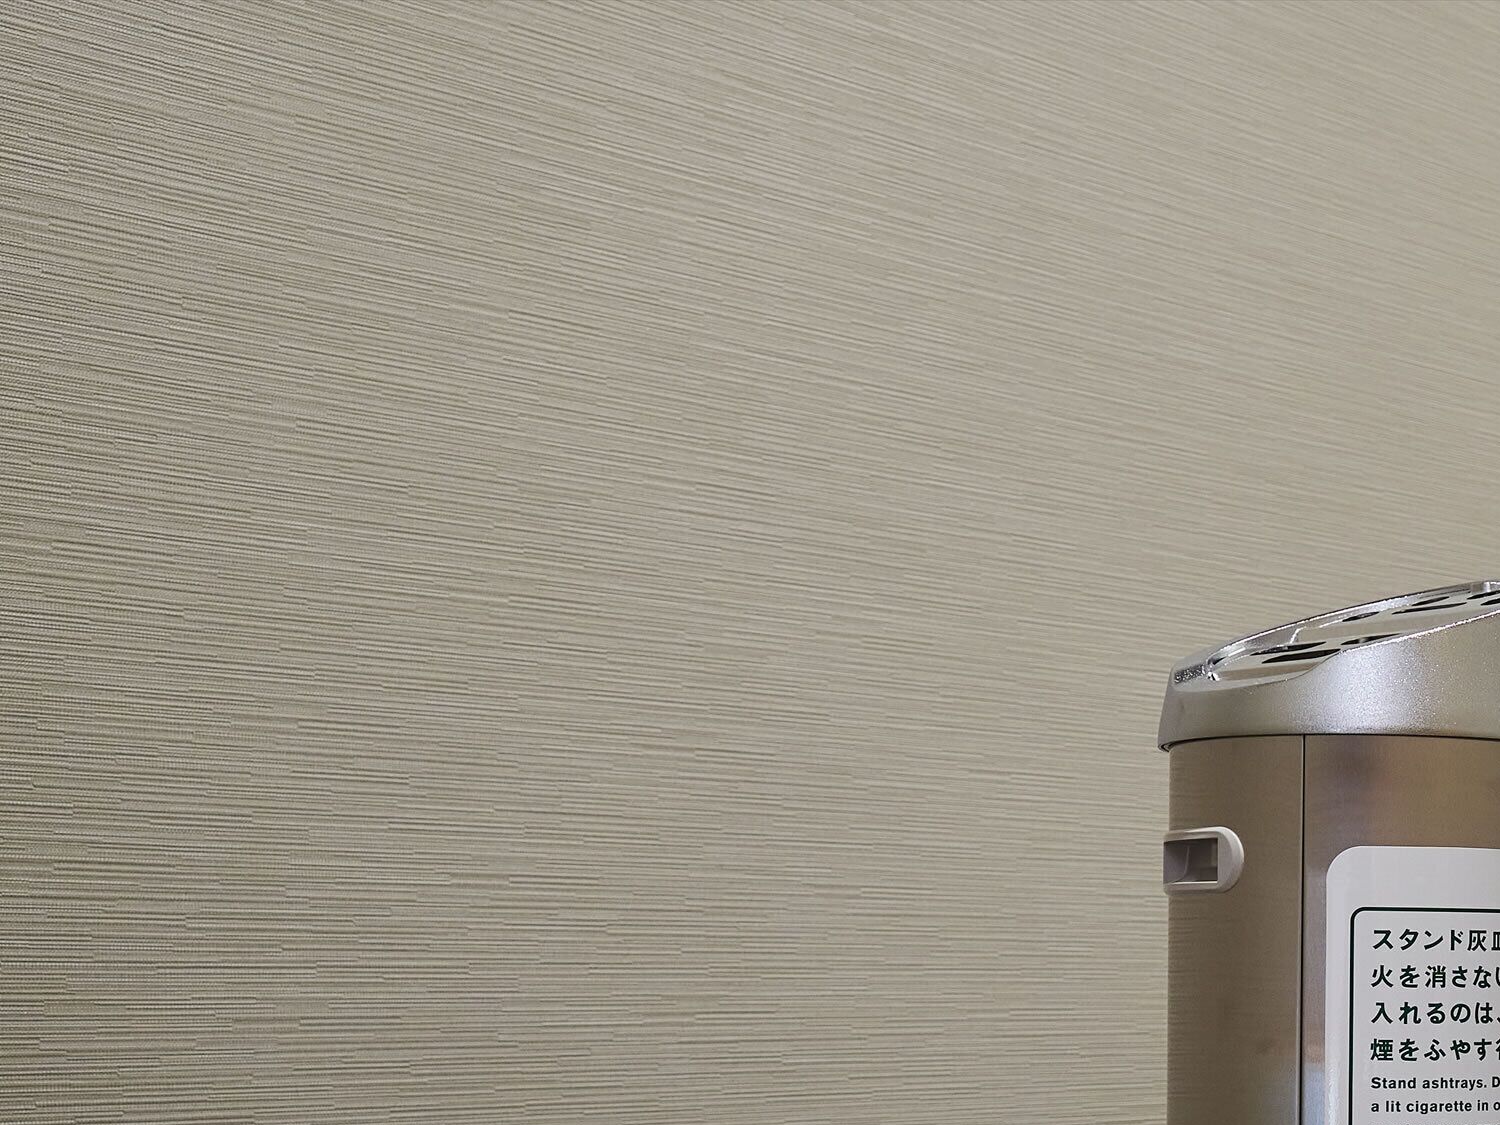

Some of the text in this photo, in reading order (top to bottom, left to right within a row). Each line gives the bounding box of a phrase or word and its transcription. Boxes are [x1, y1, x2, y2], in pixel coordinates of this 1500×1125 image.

[1371, 1077, 1416, 1088] Stand
[1422, 1076, 1487, 1090] ashtrays.
[1371, 1102, 1379, 1112] a
[1385, 1101, 1400, 1112] lit
[1406, 1101, 1472, 1114] cigarette
[1477, 1100, 1489, 1111] in
